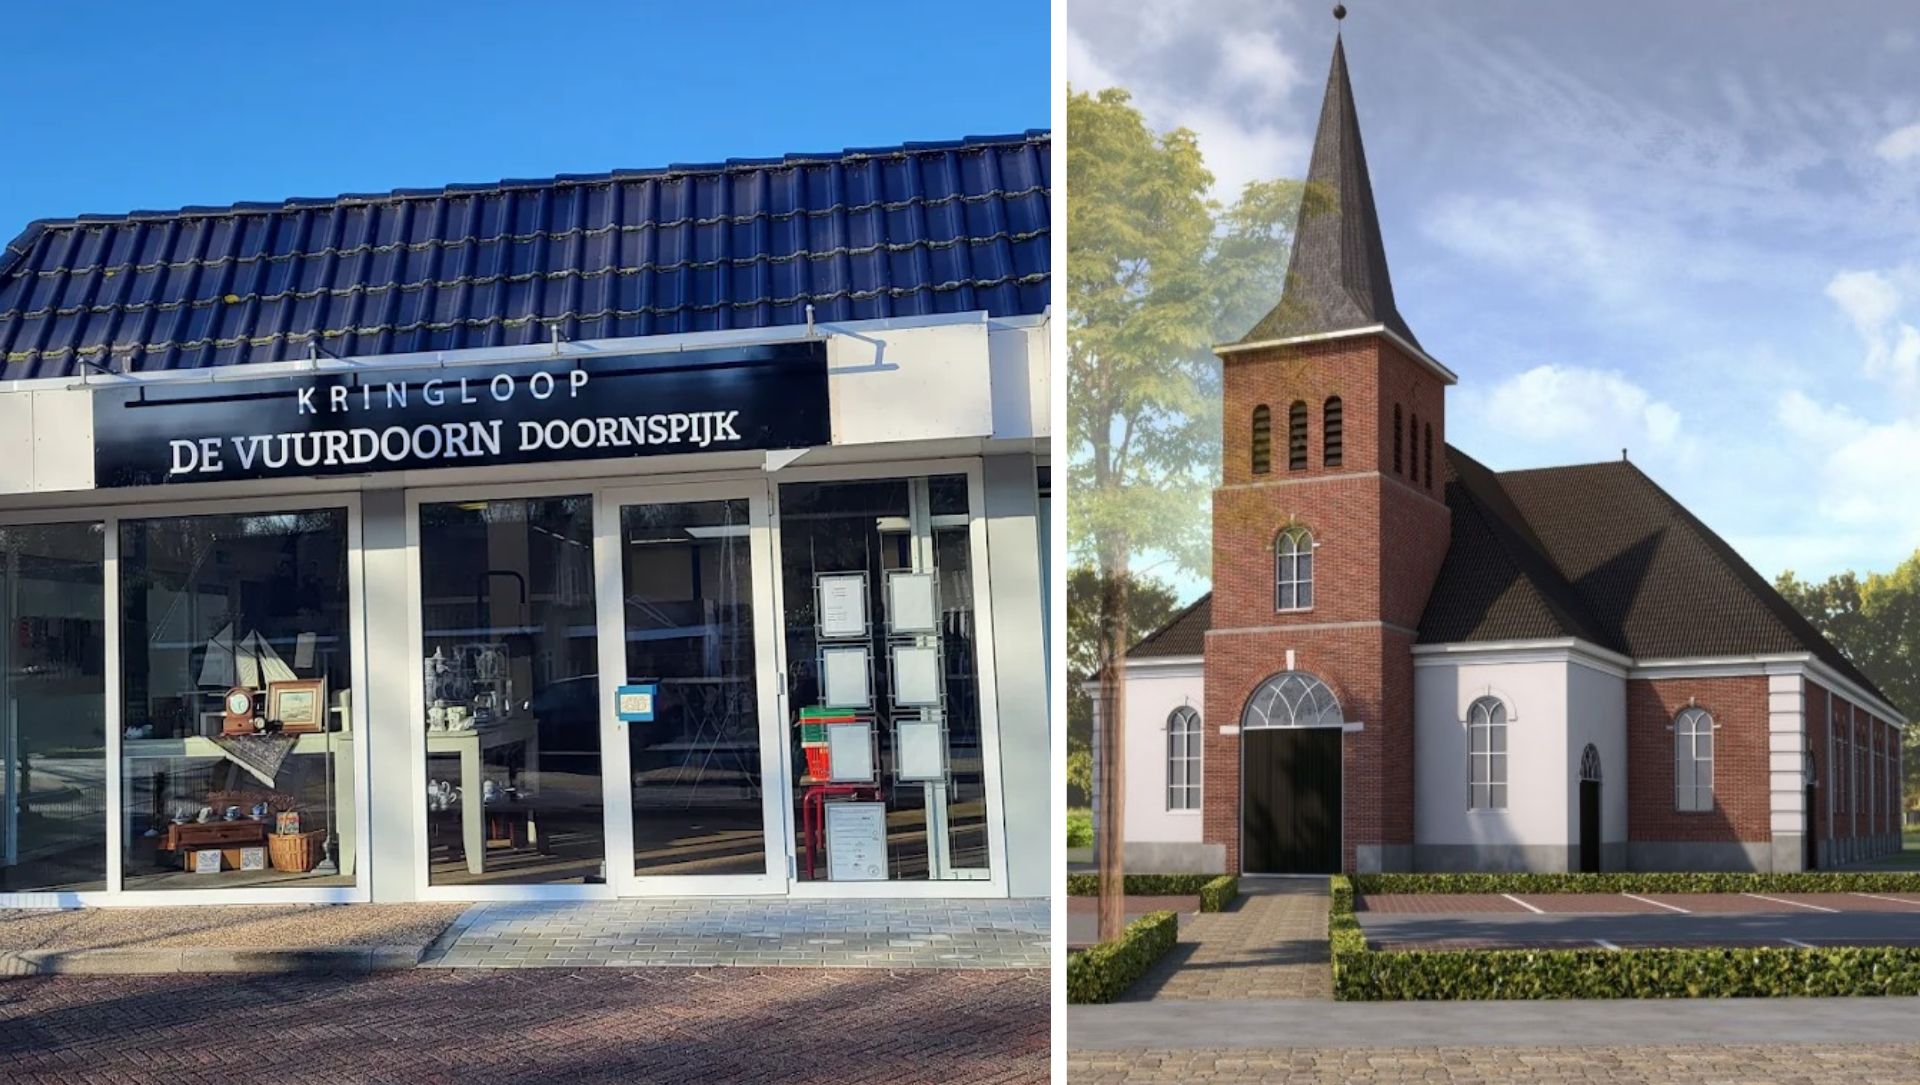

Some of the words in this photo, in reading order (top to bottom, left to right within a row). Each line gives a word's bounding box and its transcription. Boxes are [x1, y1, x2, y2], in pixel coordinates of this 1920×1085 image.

[298, 370, 589, 414] KRINGLOOP
[169, 437, 223, 474] DE
[231, 419, 503, 469] VUURDOORN
[518, 410, 741, 451] DOORNSPIJK
